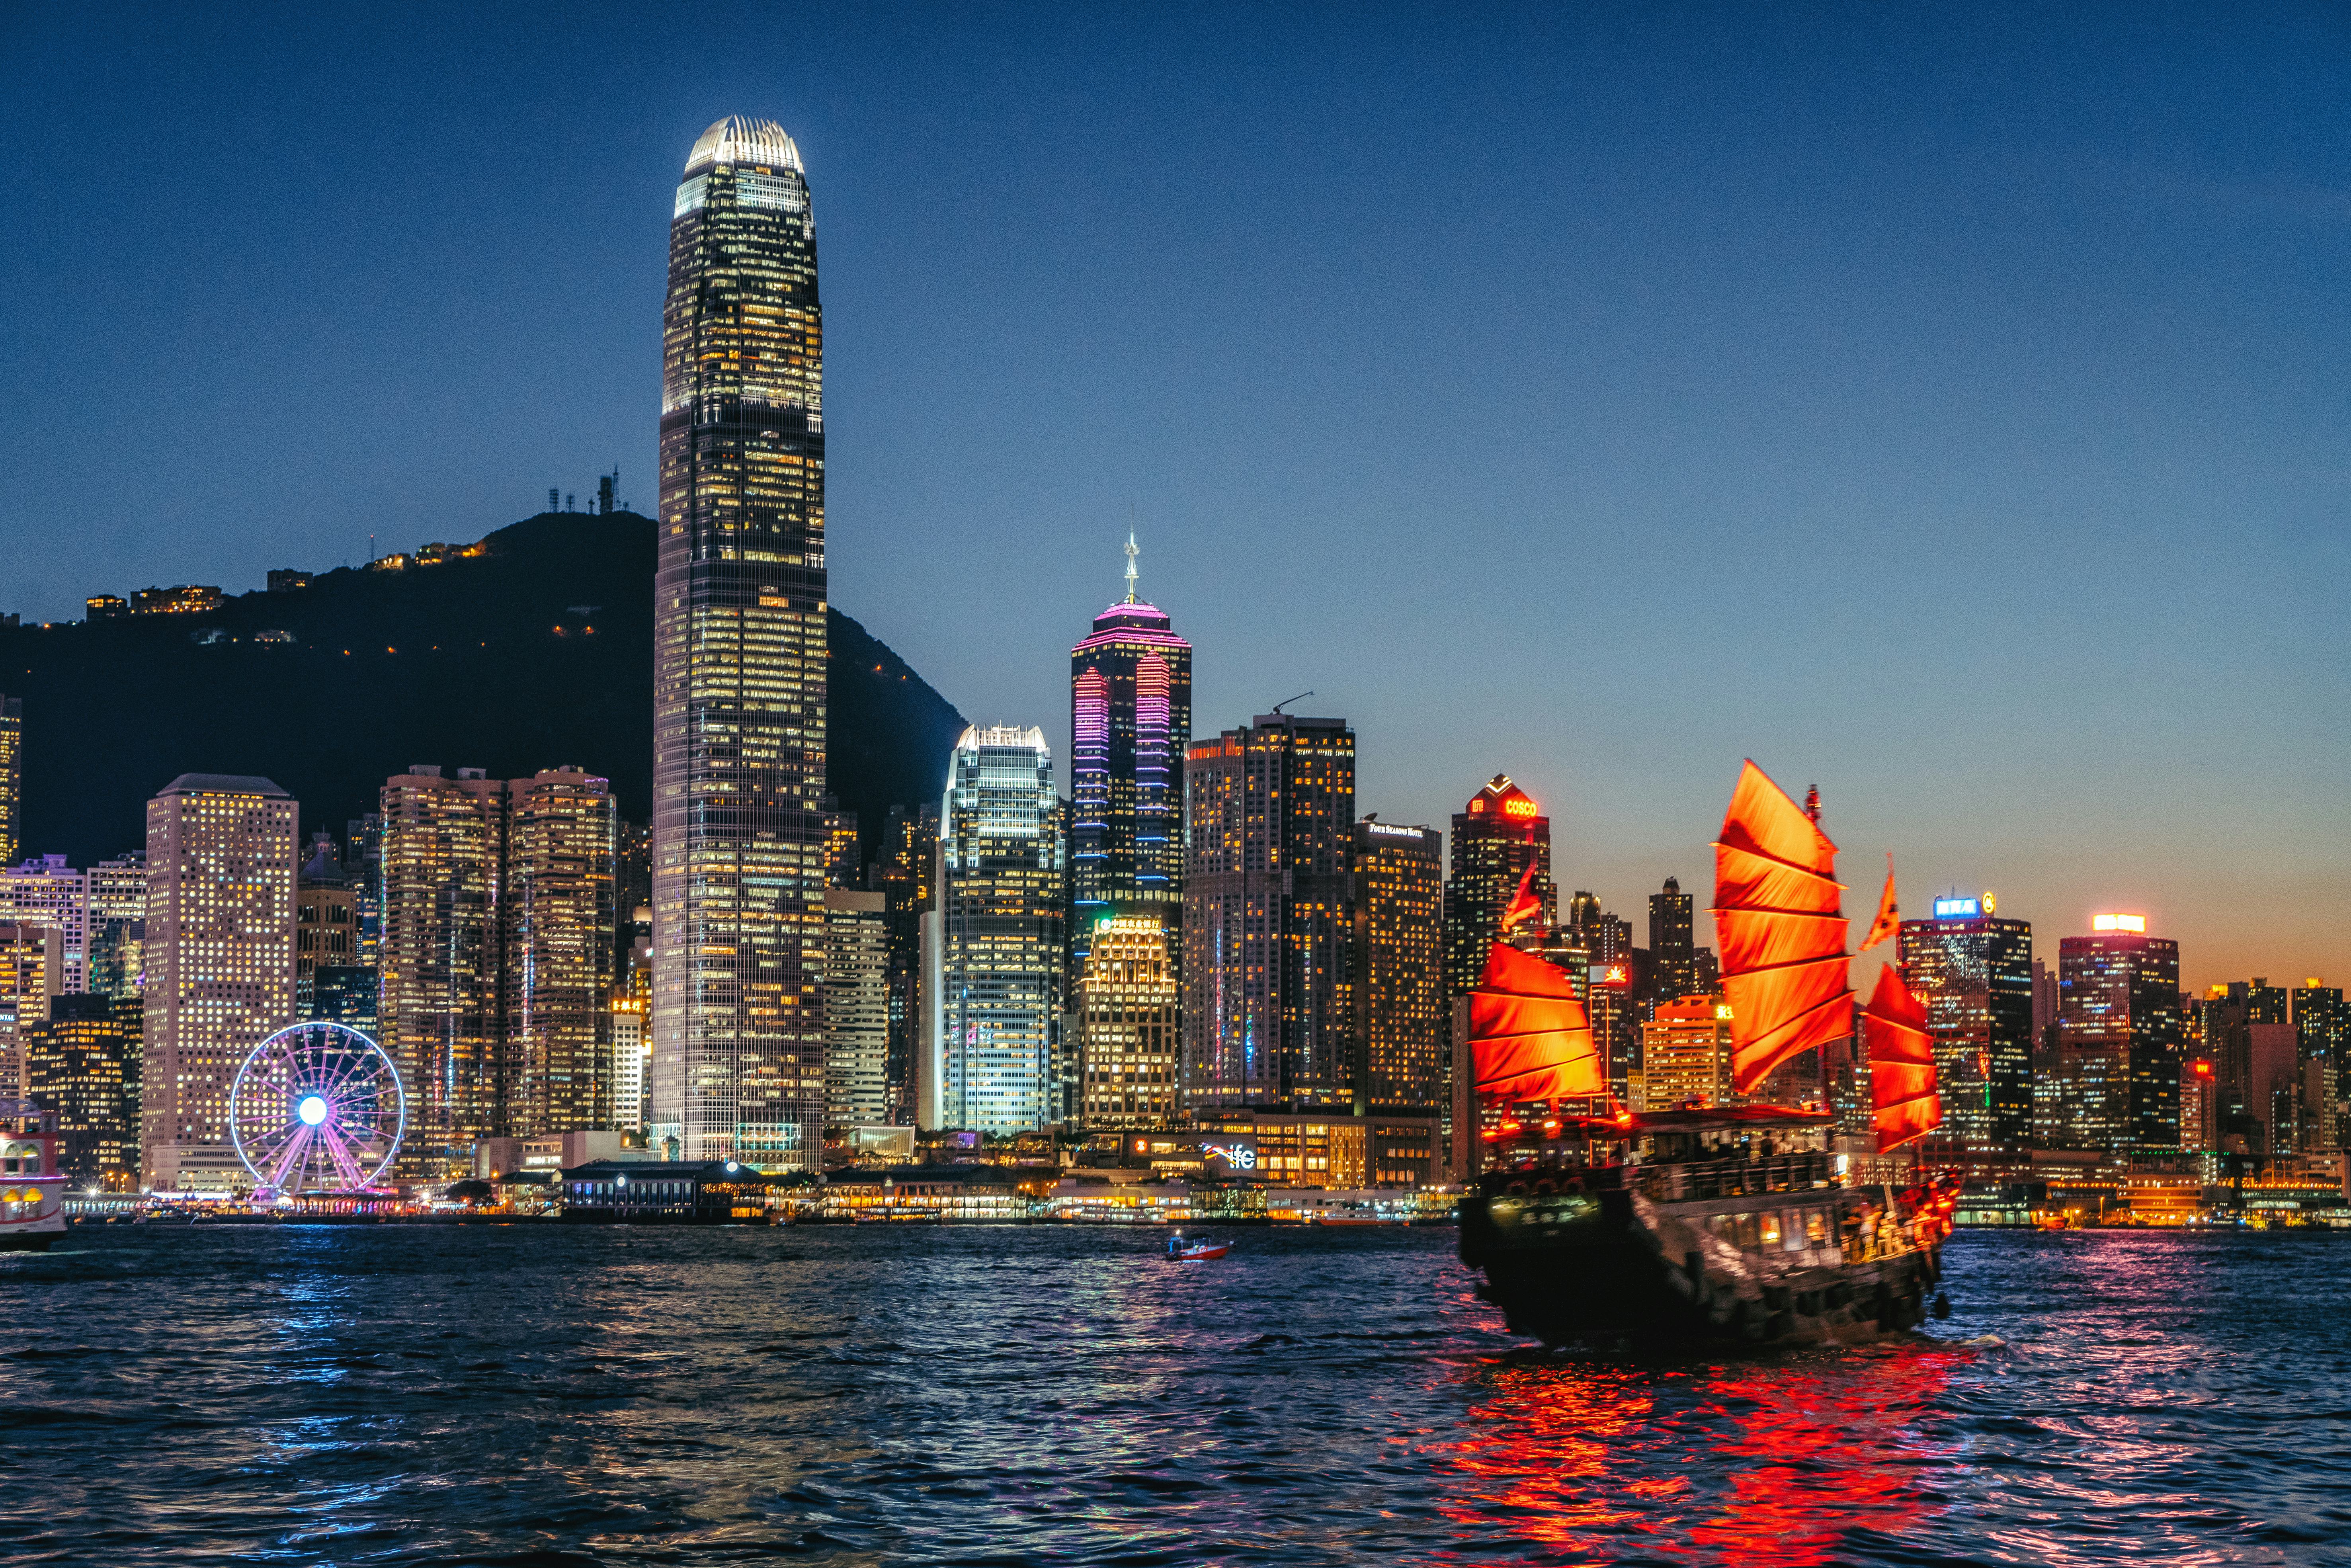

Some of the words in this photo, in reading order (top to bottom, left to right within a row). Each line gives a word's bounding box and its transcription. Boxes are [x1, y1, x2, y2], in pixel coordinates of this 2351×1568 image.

[1506, 800, 1537, 816] COSCO
[1369, 823, 1385, 833] FOUR
[1386, 825, 1407, 836] SEASONS
[1407, 827, 1423, 838] HOTEL
[1230, 1144, 1254, 1169] ifc
